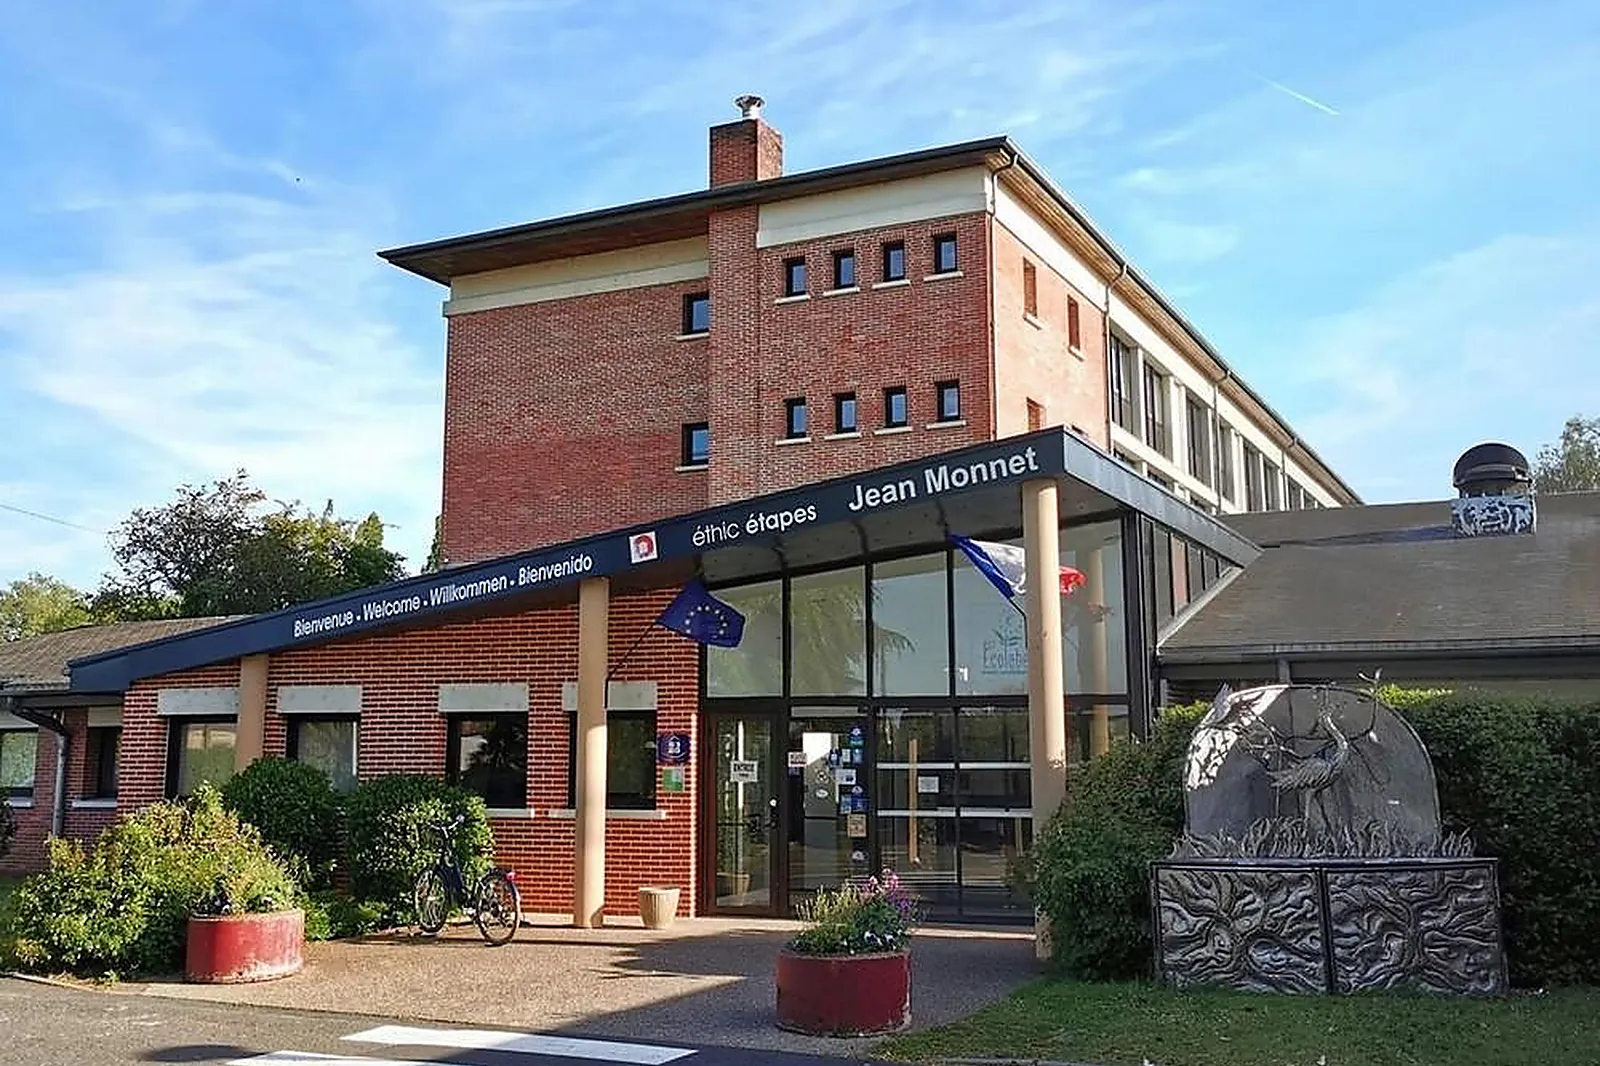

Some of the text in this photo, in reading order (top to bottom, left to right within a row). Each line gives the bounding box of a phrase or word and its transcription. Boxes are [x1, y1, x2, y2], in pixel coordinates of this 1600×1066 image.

[848, 447, 1039, 511] Jean Monnet
[692, 505, 817, 547] éthic étapes
[293, 554, 593, 638] Bienvenue Welcome Willkommen Bienvenido
